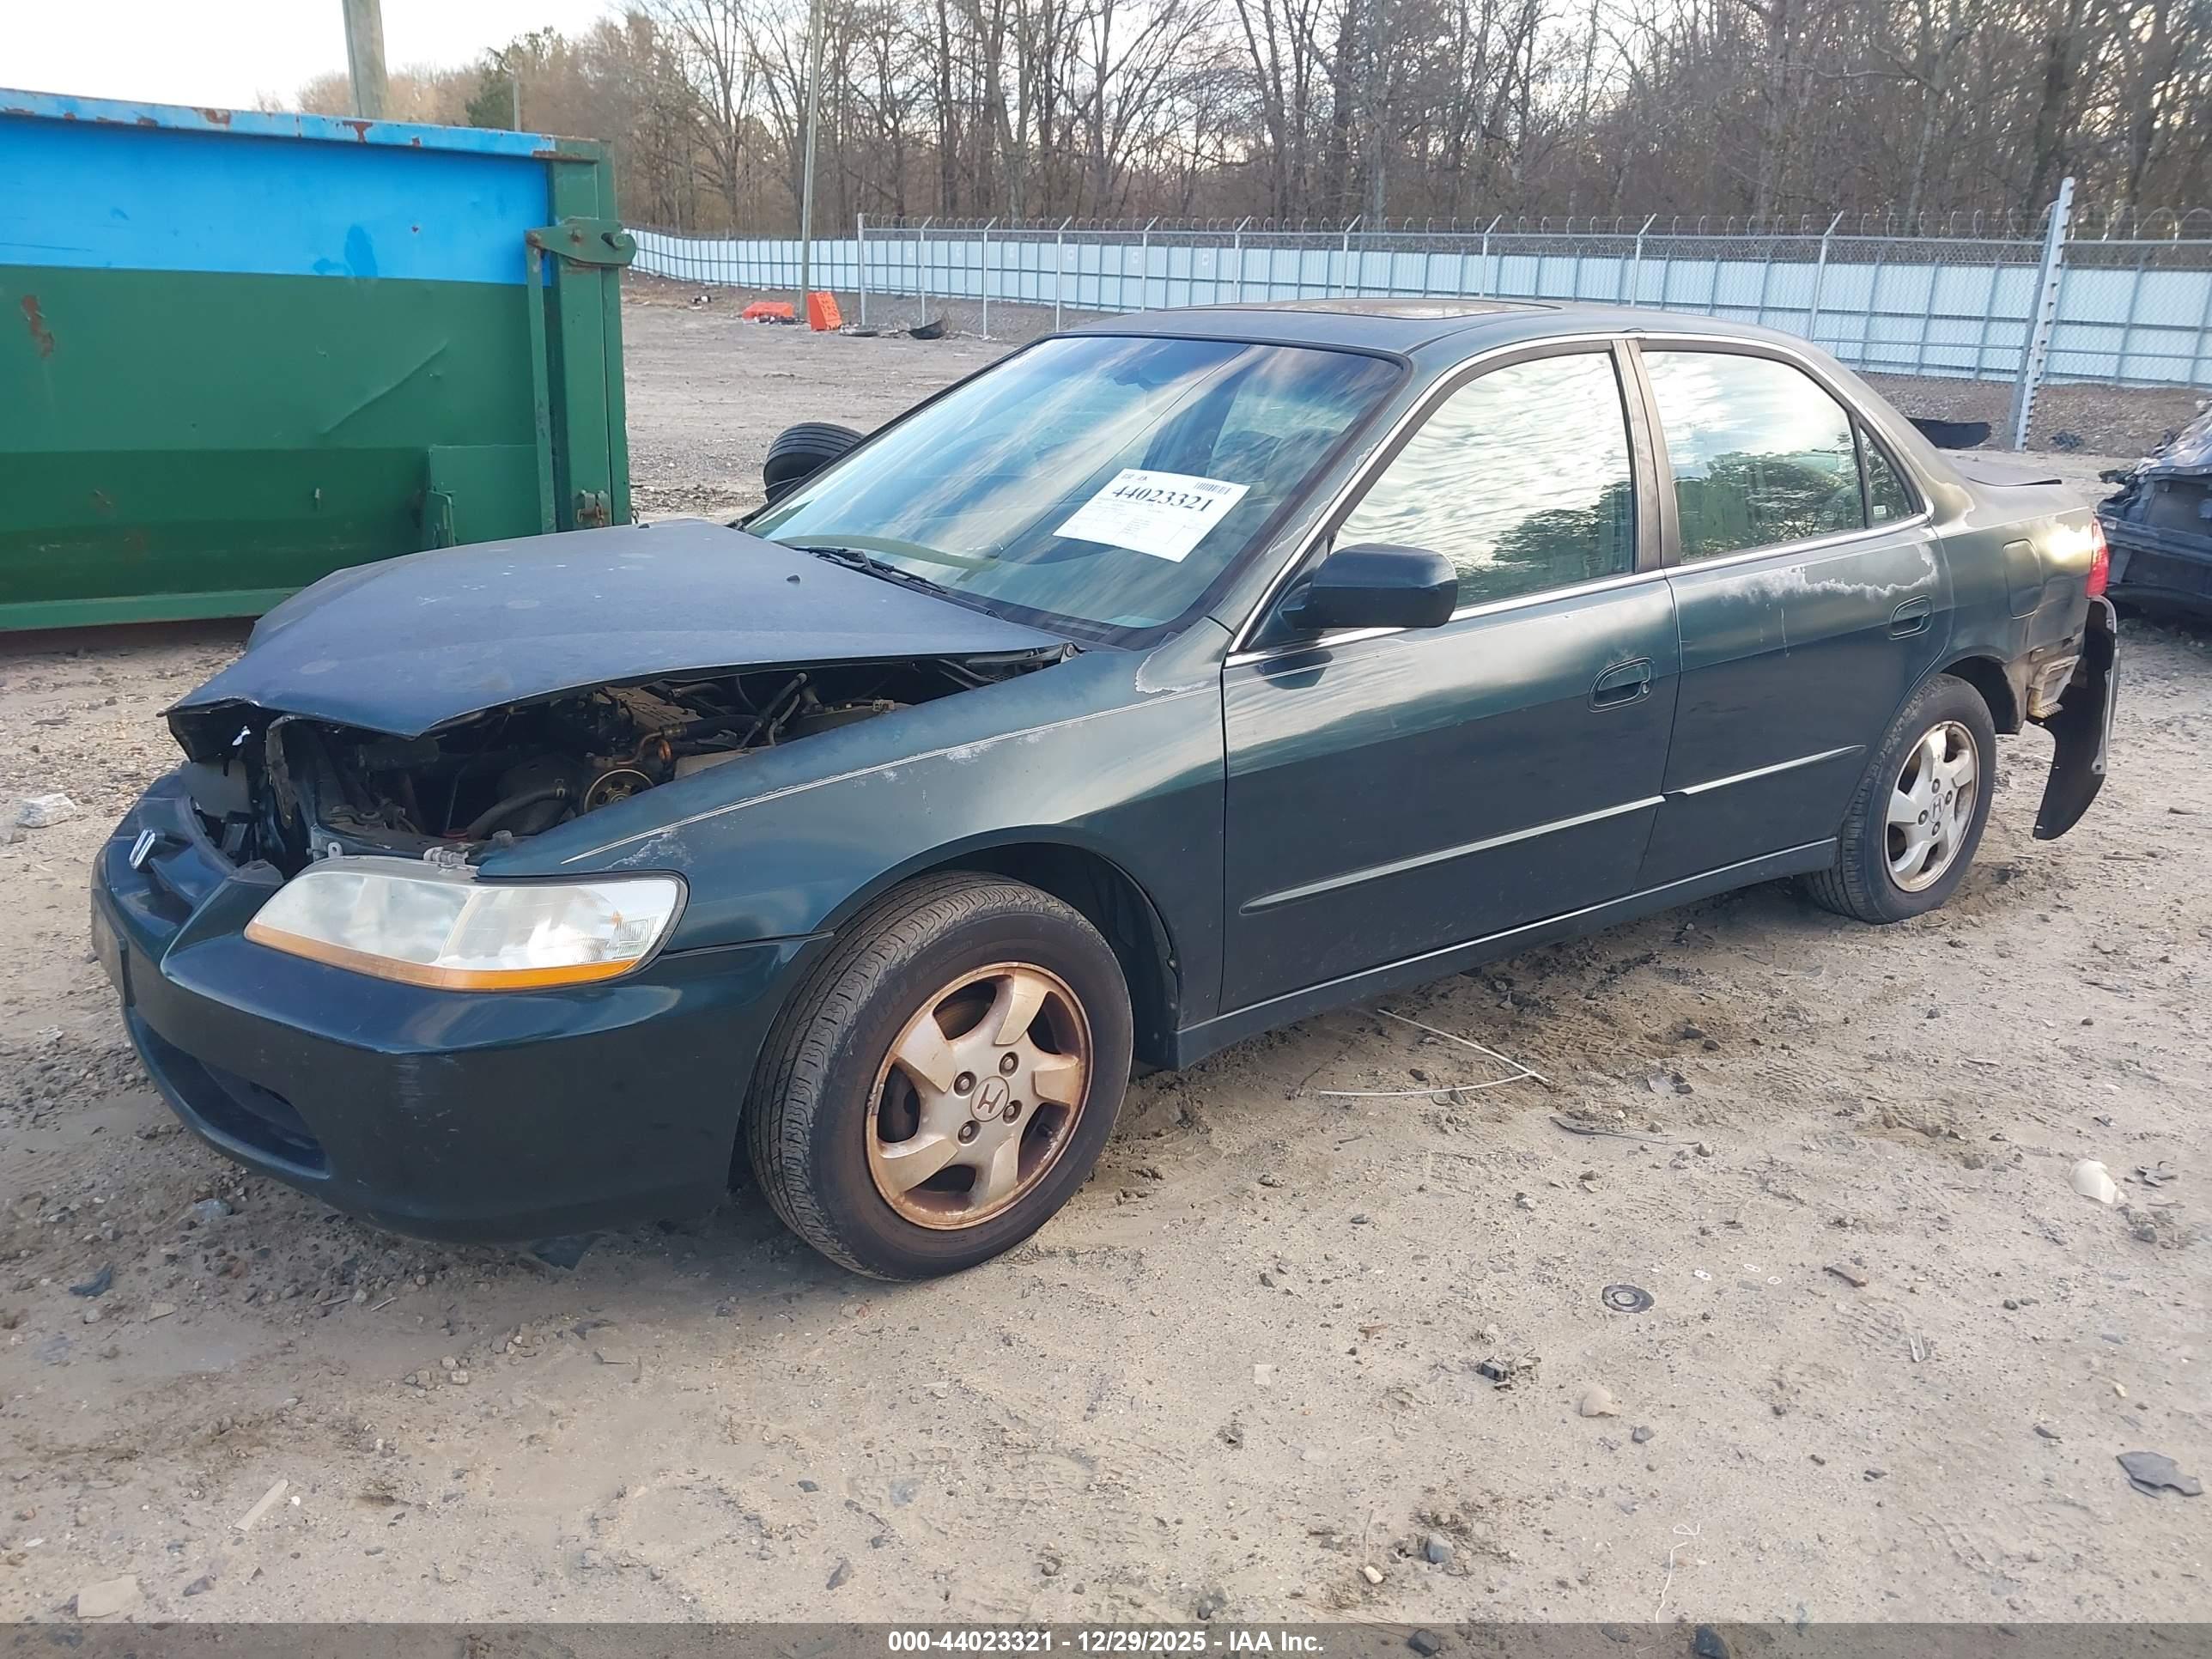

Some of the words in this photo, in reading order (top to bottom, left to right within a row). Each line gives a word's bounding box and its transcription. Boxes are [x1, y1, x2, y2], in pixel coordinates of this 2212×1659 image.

[1112, 484, 1214, 512] 44023321
[1932, 798, 1942, 819] H
[976, 1083, 1004, 1114] H
